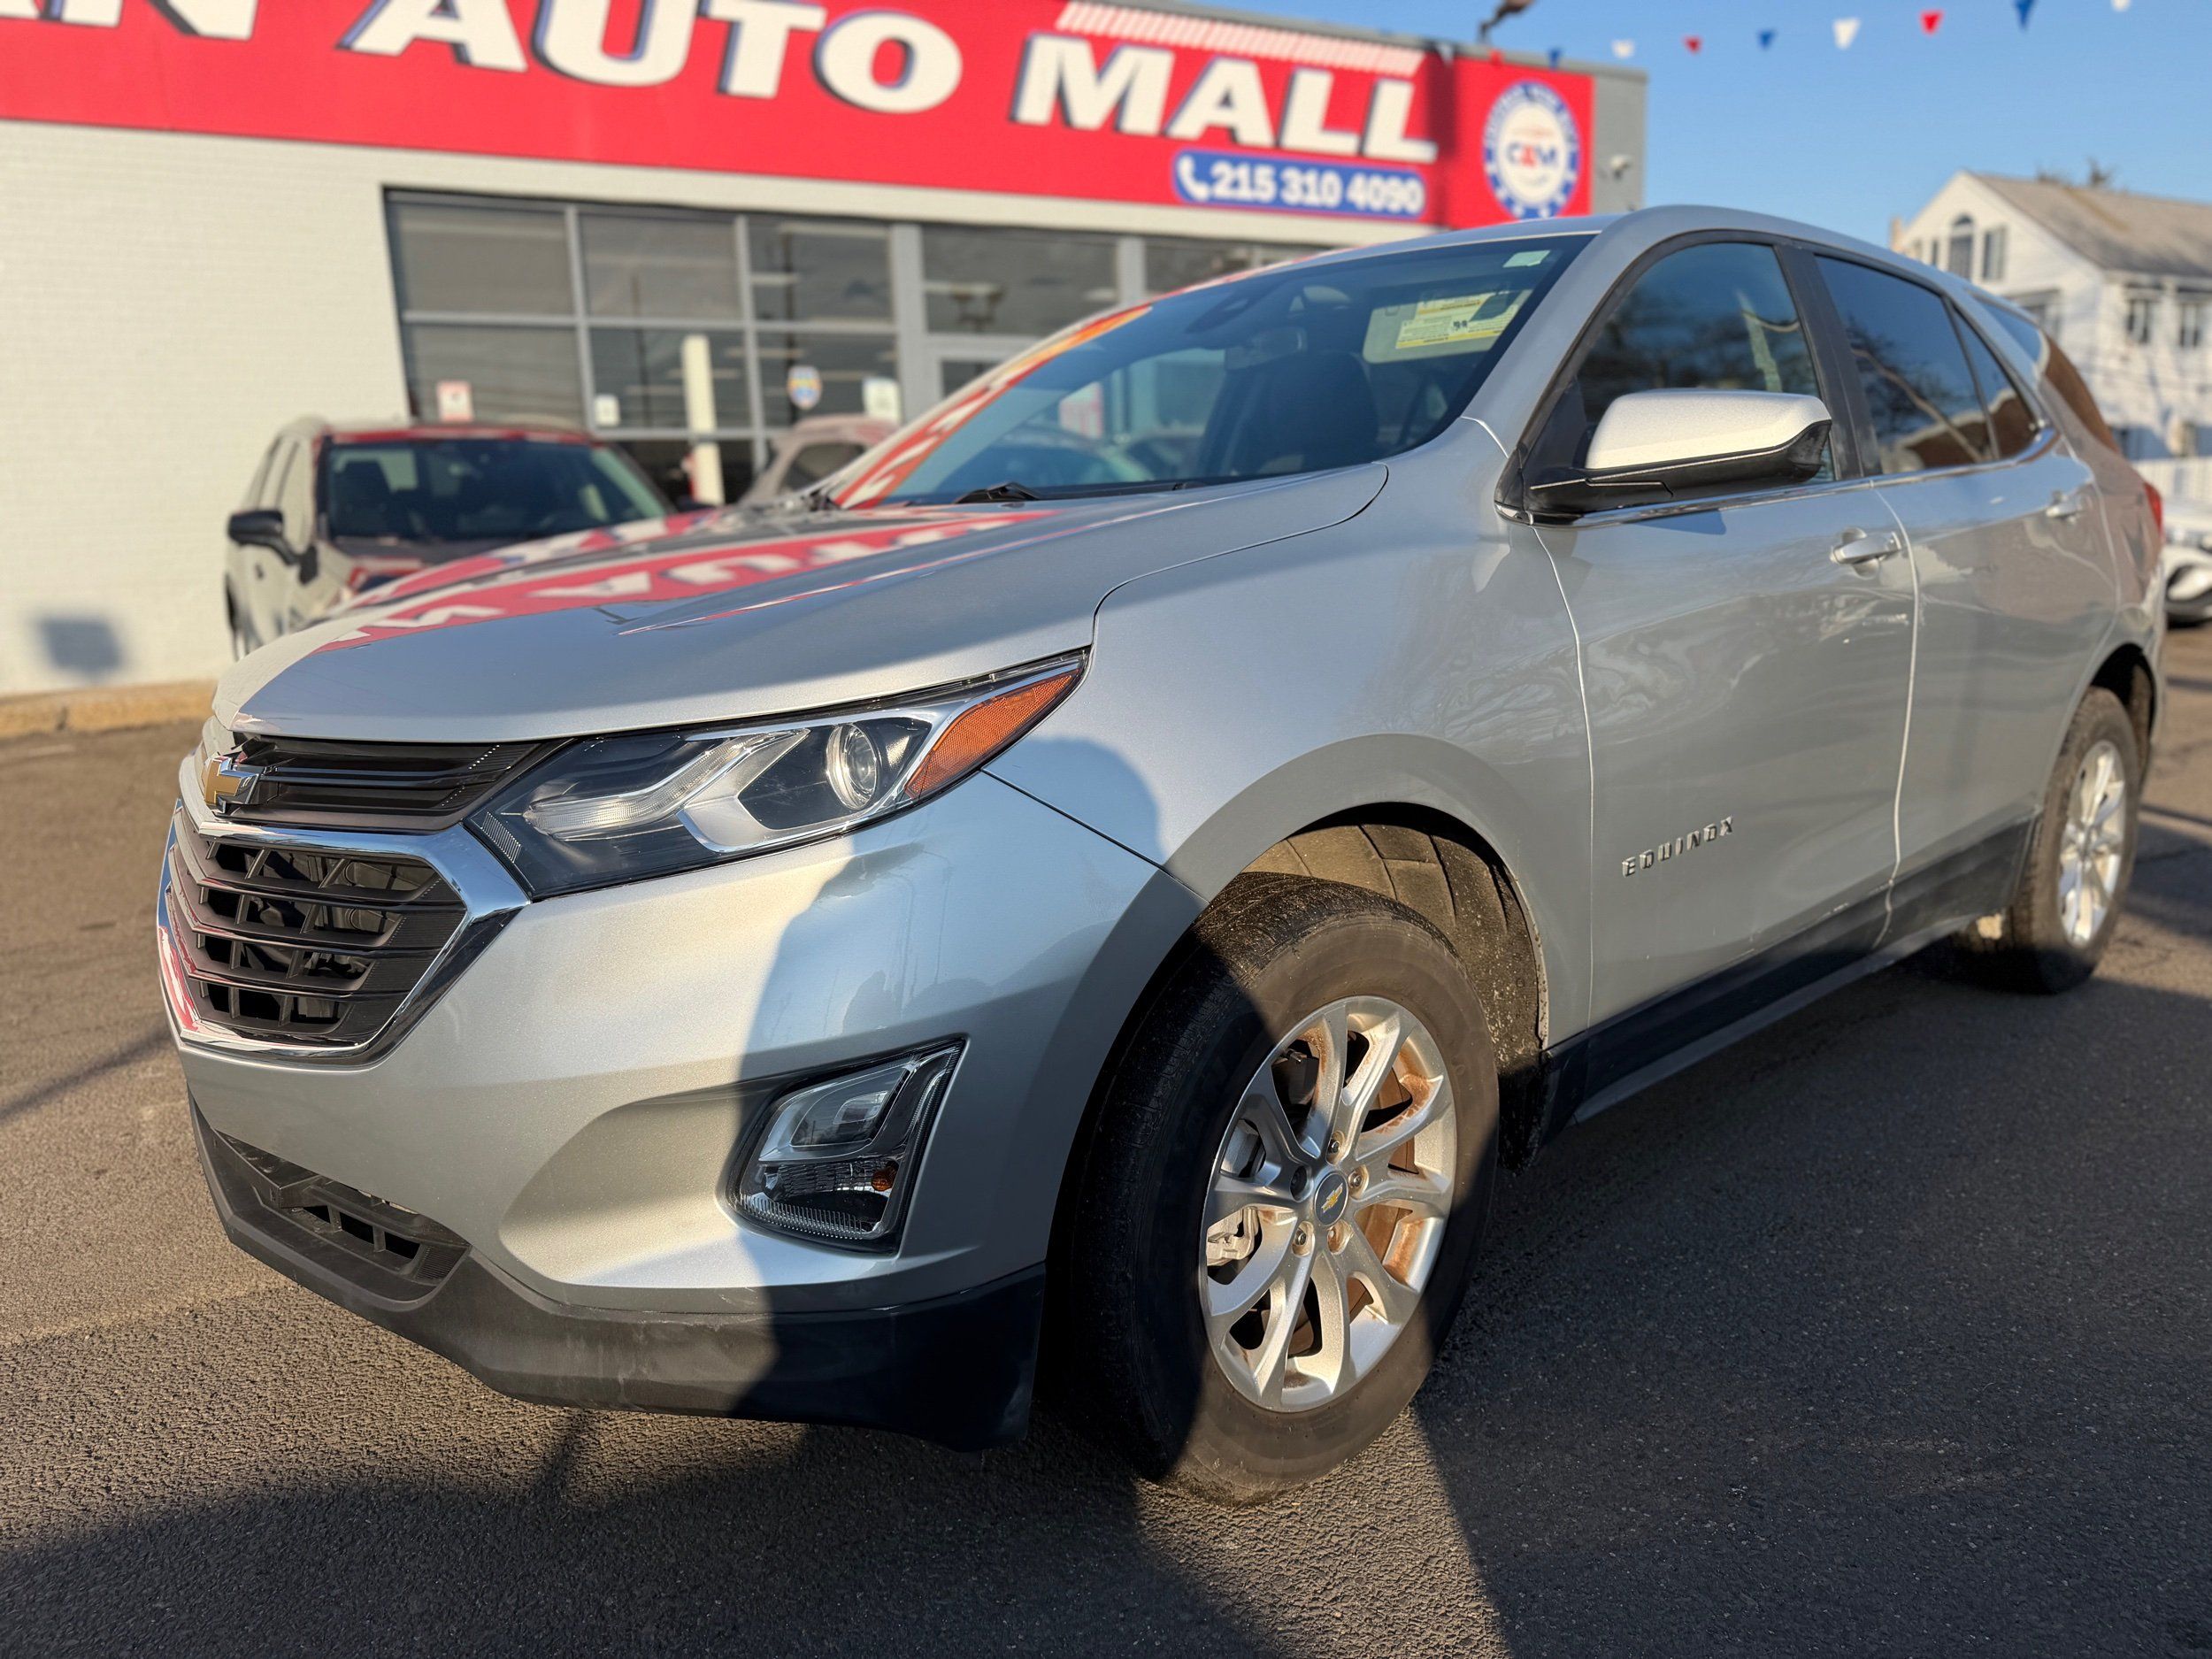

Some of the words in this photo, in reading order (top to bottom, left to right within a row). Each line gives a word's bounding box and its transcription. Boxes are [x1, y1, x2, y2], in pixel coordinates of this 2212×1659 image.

[336, 0, 964, 113] AUTO
[1008, 32, 1438, 163] MALL
[1210, 161, 1278, 203] 215
[1279, 166, 1343, 209] 310
[1621, 815, 1734, 878] EQUINOX
